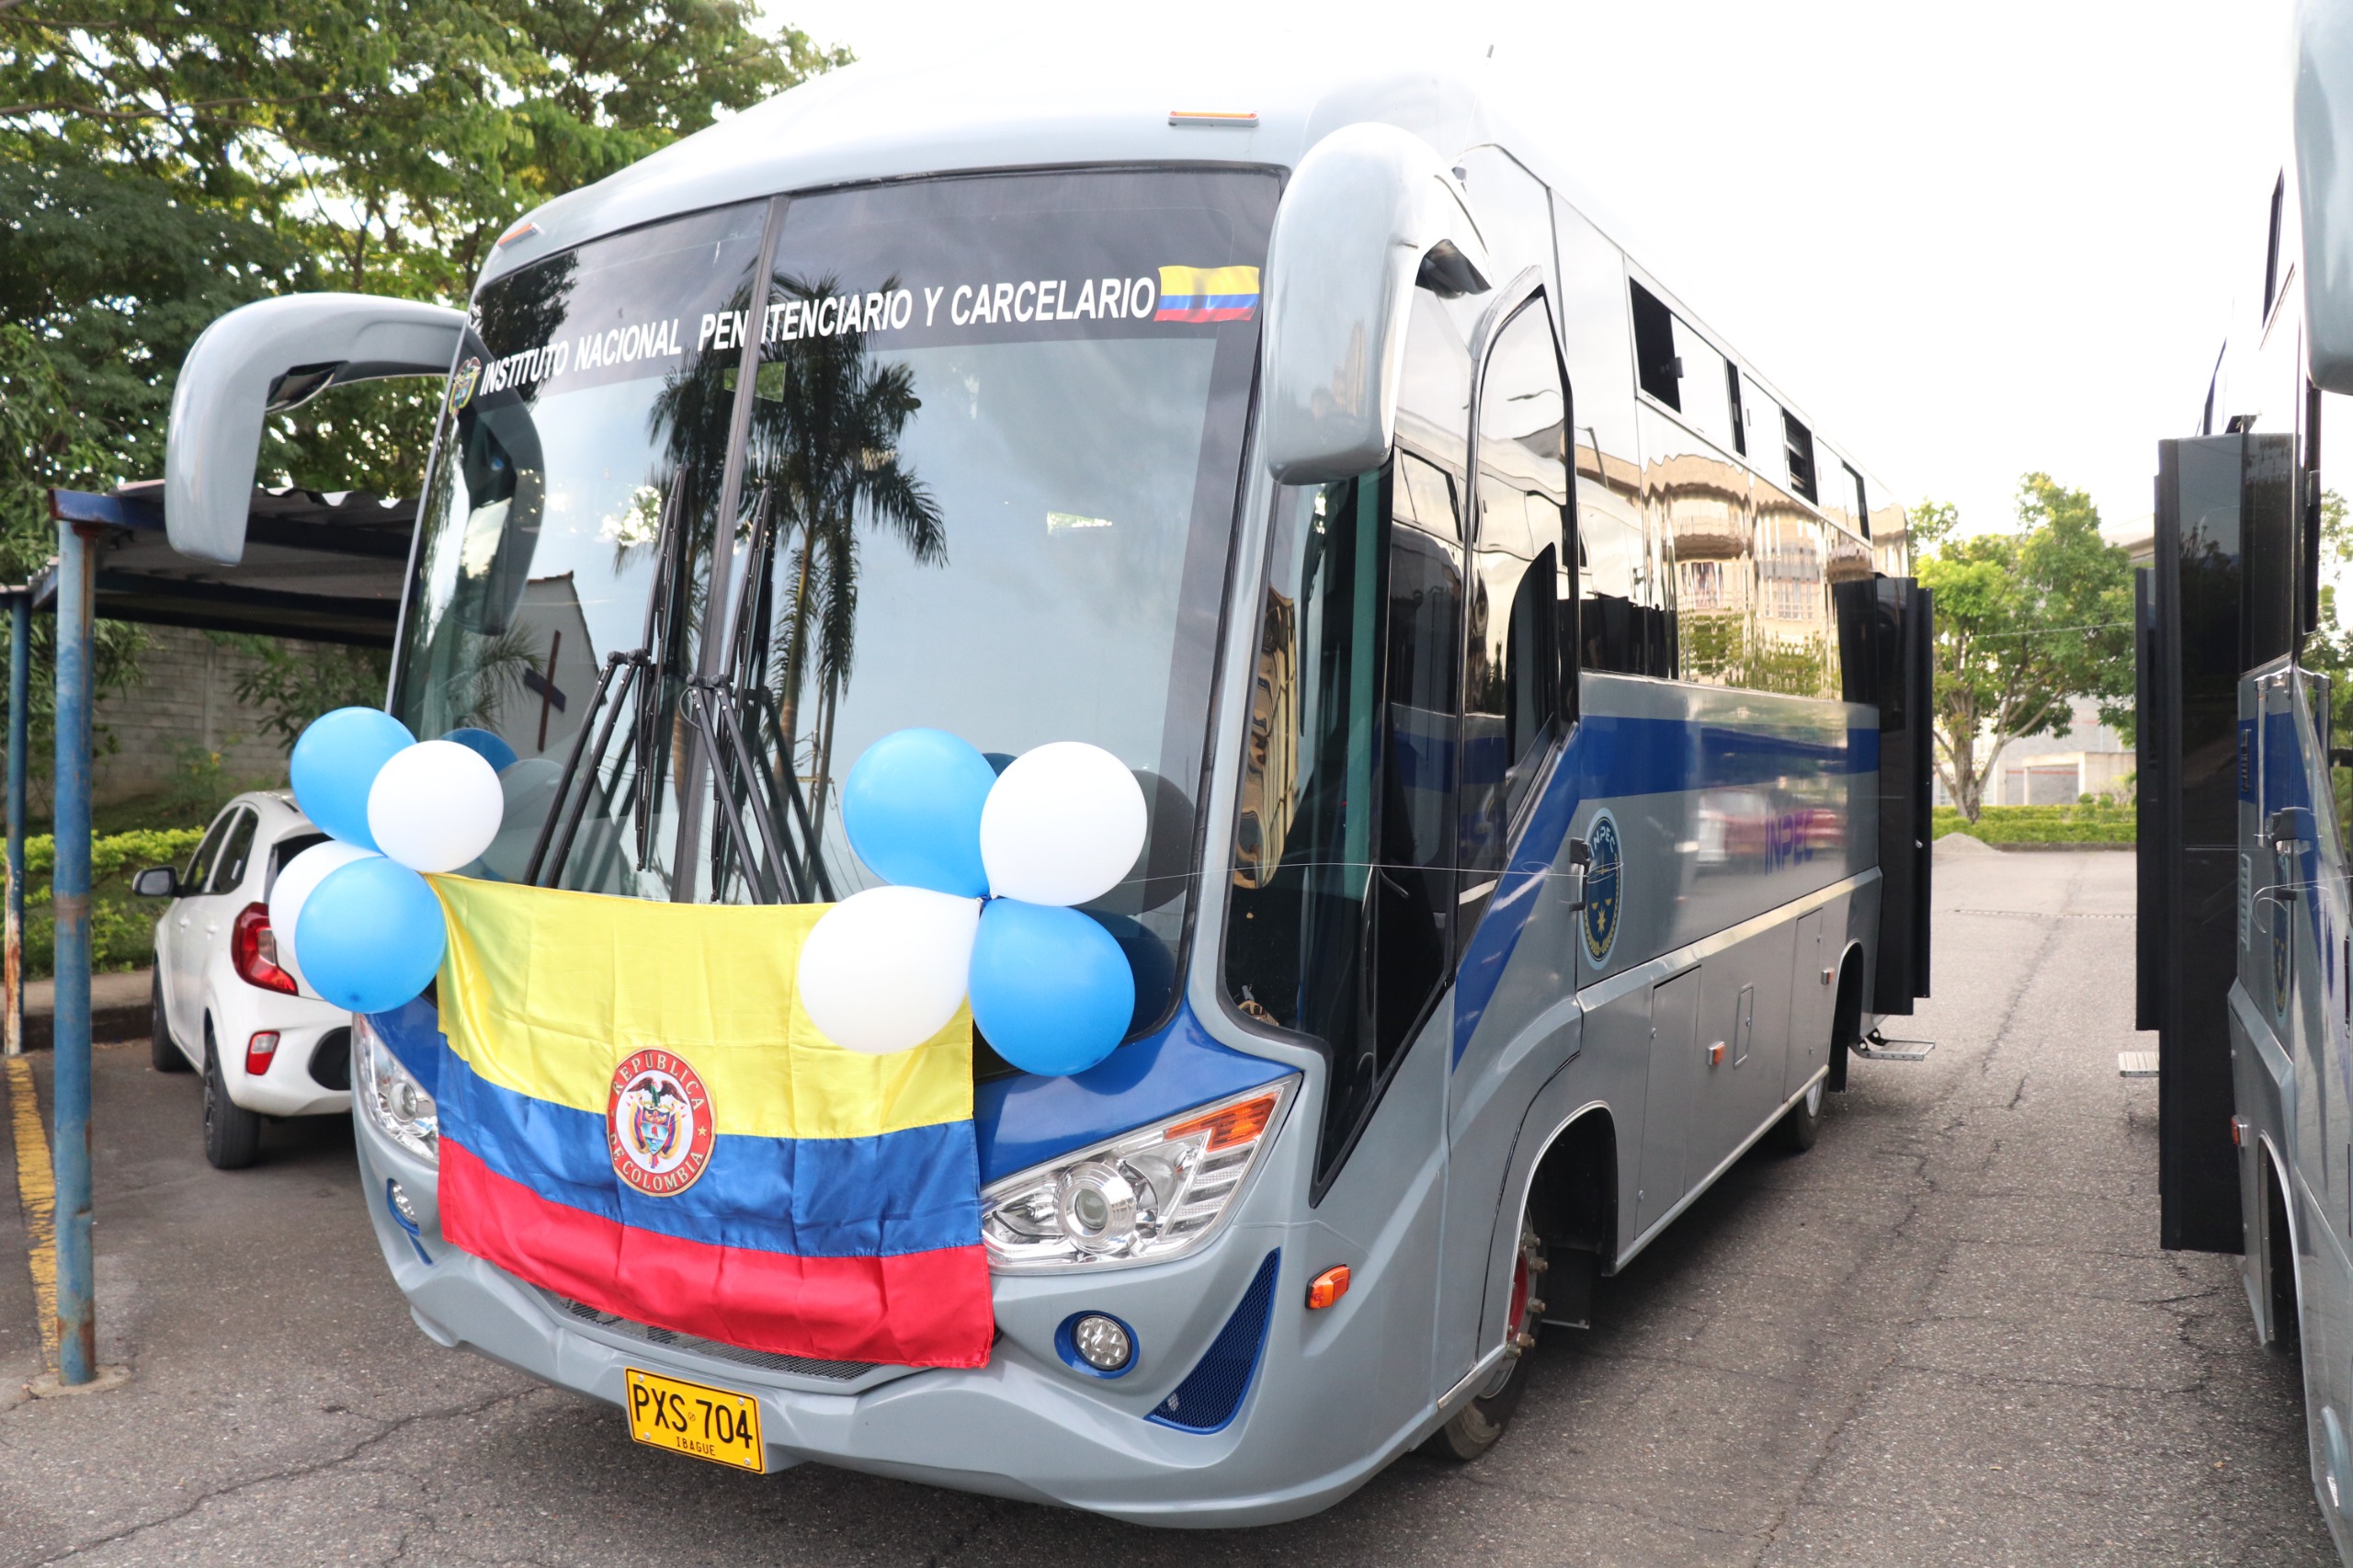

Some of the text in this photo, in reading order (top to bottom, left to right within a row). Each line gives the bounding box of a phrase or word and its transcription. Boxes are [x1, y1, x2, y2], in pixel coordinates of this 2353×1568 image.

[480, 277, 1155, 396] INSTITUTO NACIONAL PENITENCIARIO Y CARCELARIO
[1589, 826, 1616, 858] INPEC
[1765, 809, 1813, 877] INPEC
[612, 1053, 705, 1111] REPUBLICA
[609, 1133, 705, 1192] DE COLOMBIA
[633, 1383, 753, 1449] PXS 704
[676, 1436, 716, 1456] IBAGUE
